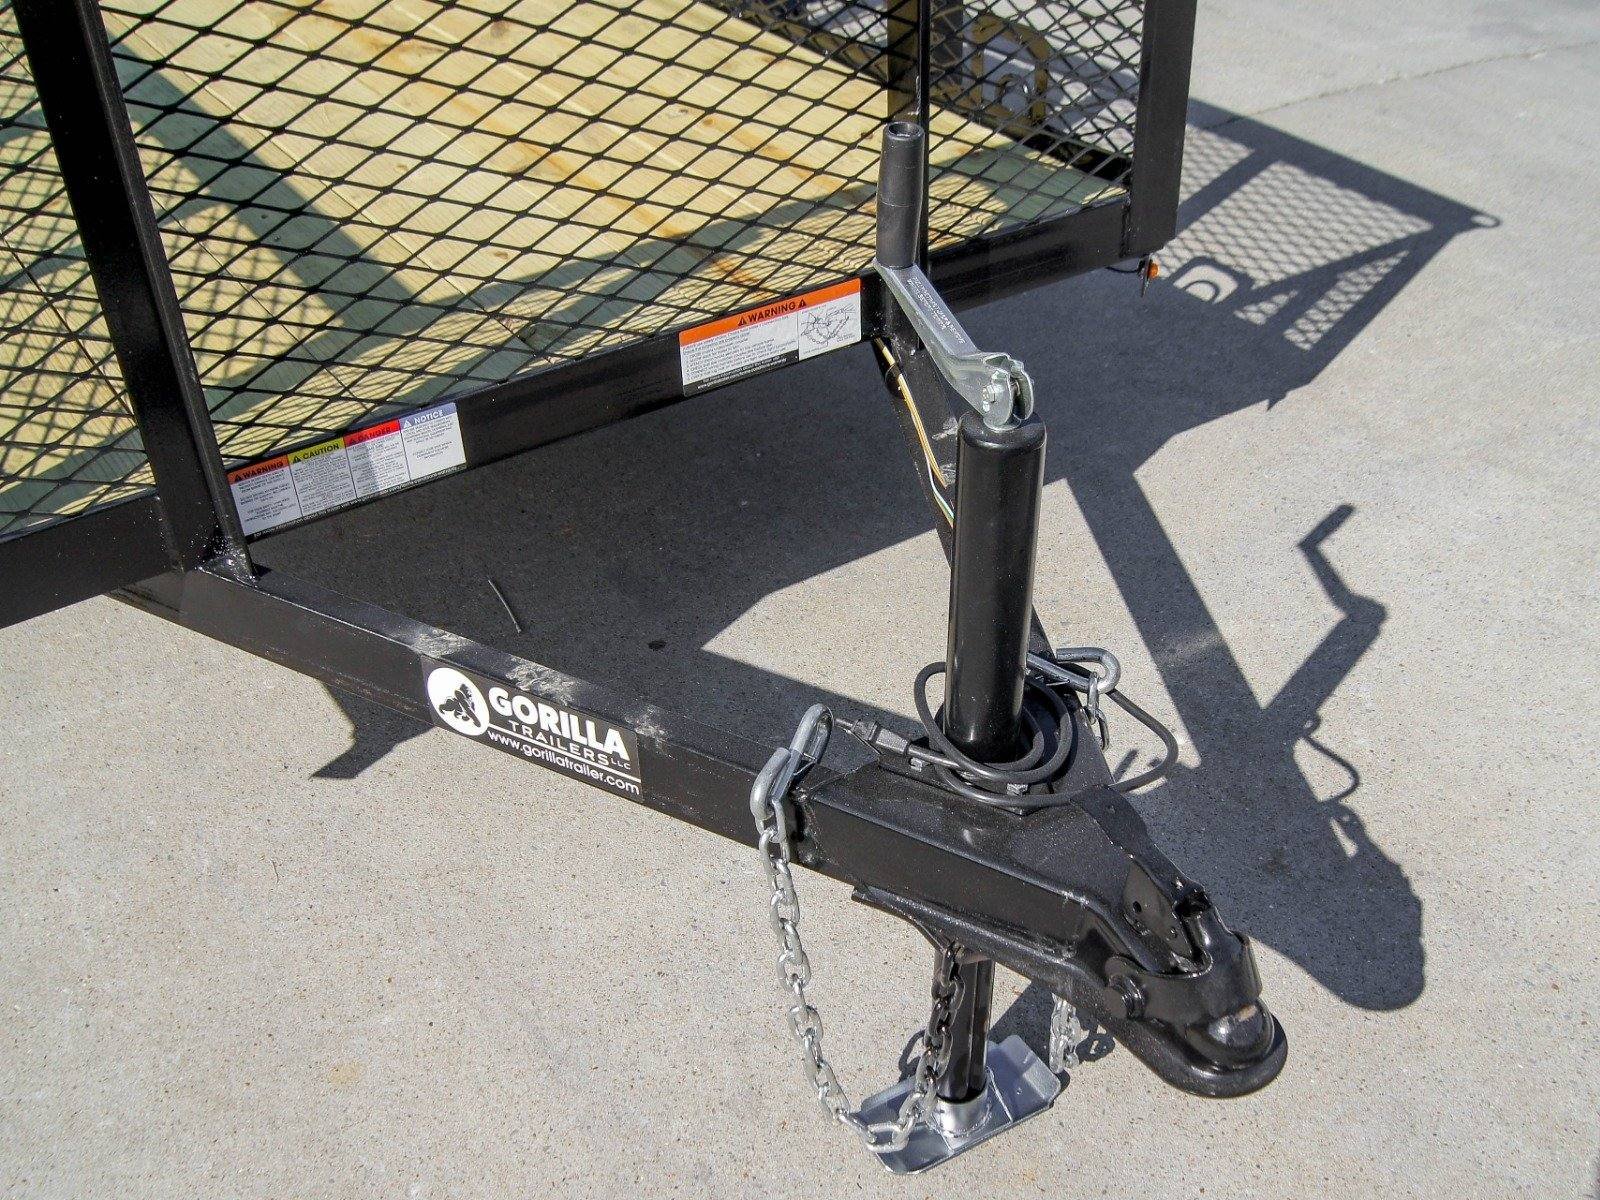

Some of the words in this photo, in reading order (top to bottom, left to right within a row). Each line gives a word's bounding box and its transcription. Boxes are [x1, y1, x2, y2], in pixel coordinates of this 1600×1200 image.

[748, 302, 796, 323] WARNING
[413, 410, 444, 424] NOTICE
[357, 427, 392, 442] DANGER
[303, 443, 340, 460] CAUTION
[242, 461, 284, 478] WARNING
[488, 687, 630, 762] GORILLA
[508, 720, 610, 767] TRAILERS
[610, 756, 631, 770] LLC
[487, 730, 640, 796] www.gorillatrailer.com
